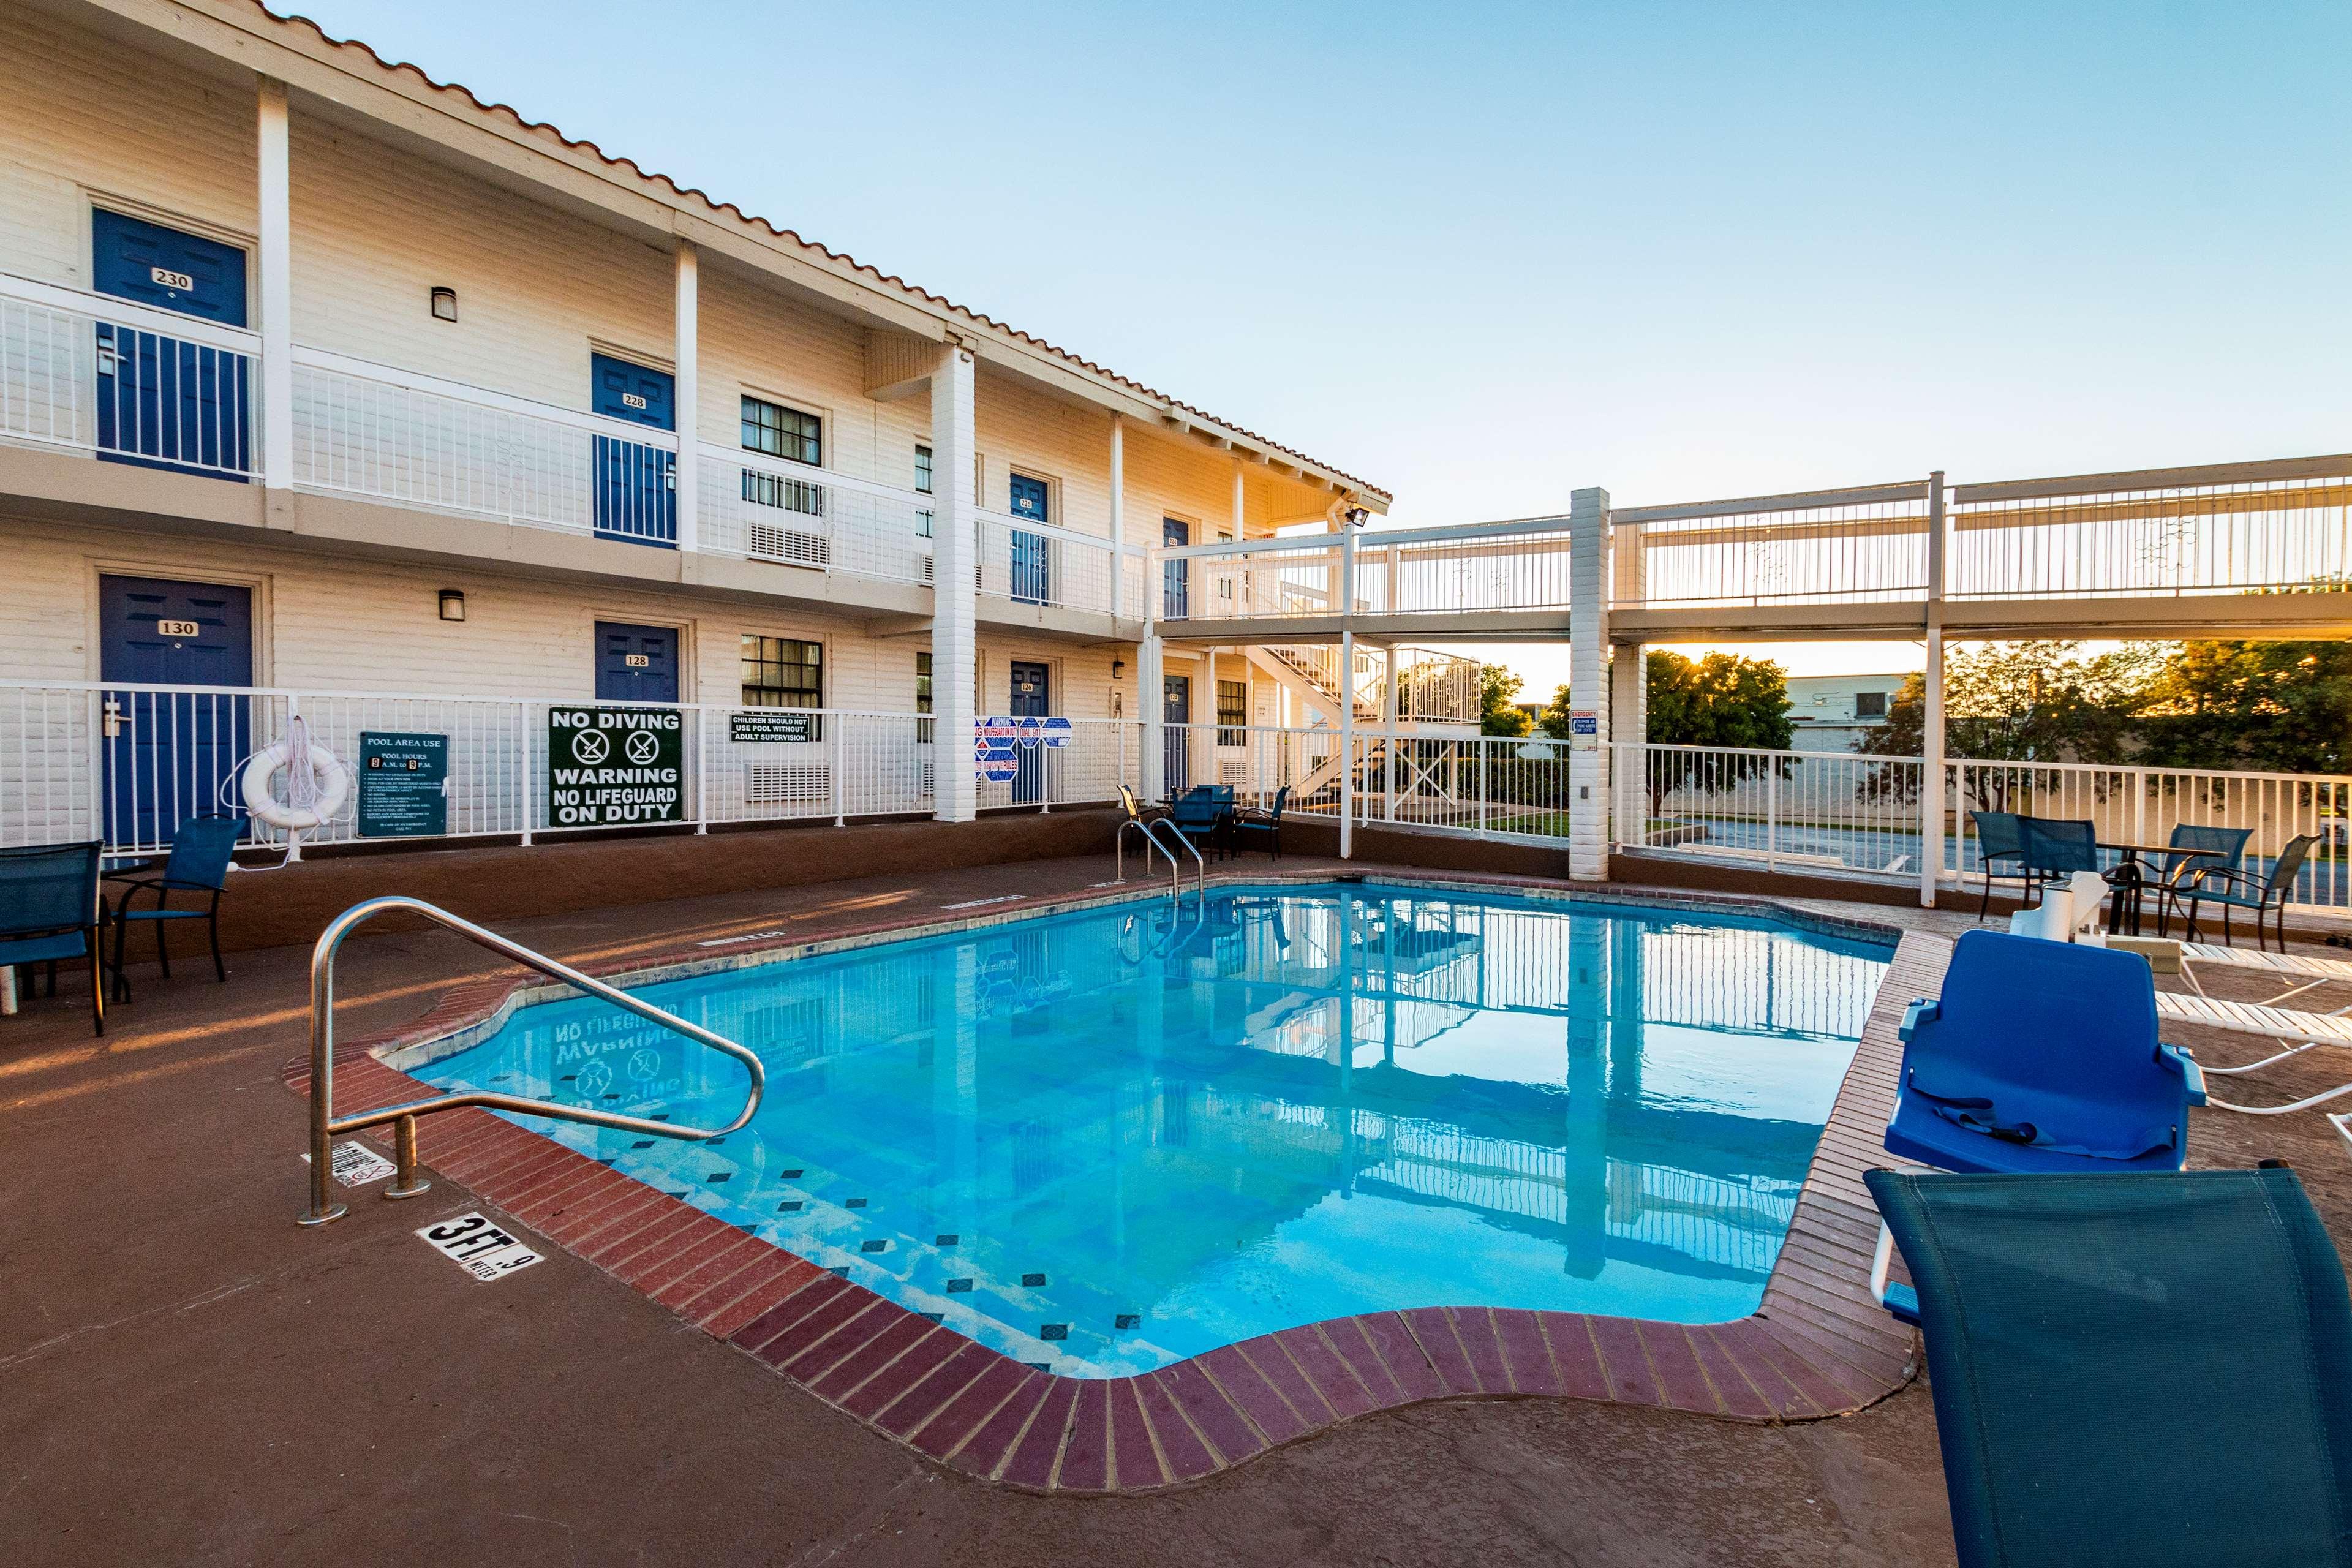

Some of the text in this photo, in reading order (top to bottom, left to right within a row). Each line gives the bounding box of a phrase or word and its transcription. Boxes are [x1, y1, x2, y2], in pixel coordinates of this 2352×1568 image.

[157, 271, 187, 287] 230
[626, 395, 643, 407] 228
[163, 622, 194, 635] 130
[628, 656, 646, 665] 128
[552, 712, 679, 729] NO DIVING
[992, 717, 1011, 726] WARNING
[1020, 728, 1031, 737] DIAL
[373, 758, 379, 767] 9
[1004, 761, 1017, 769] RULES
[554, 768, 677, 785] WARNING
[554, 787, 677, 806] NO LIFEGUARD
[559, 804, 673, 823] ON DUTY
[428, 1218, 486, 1240] 3
[467, 1261, 498, 1278] METER
